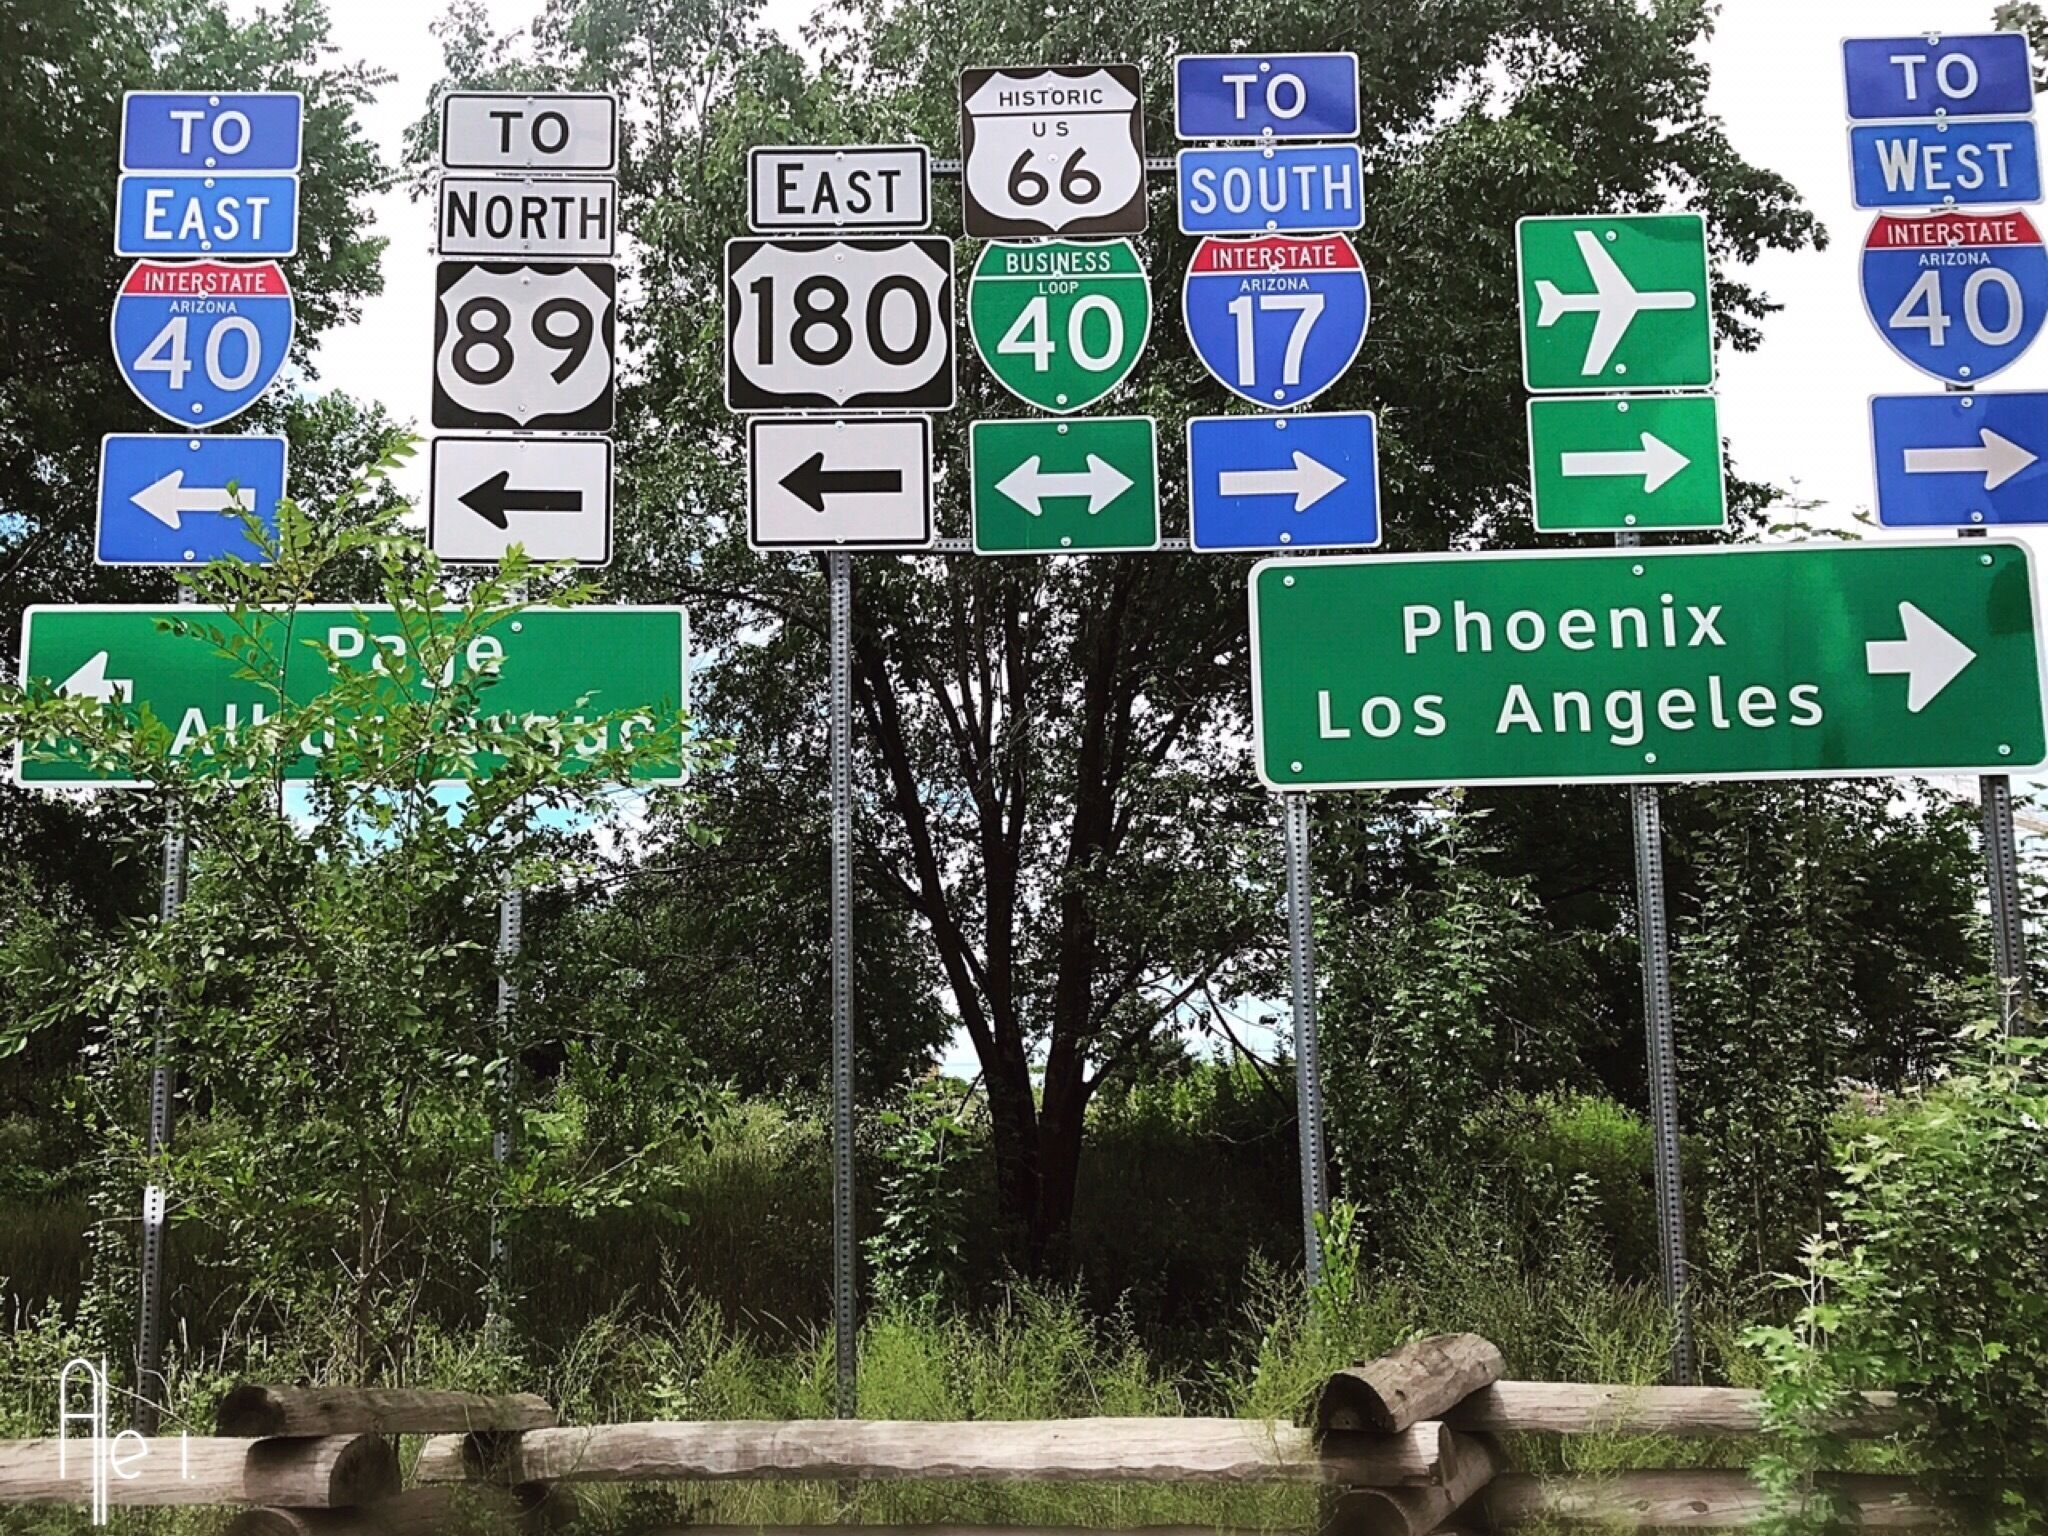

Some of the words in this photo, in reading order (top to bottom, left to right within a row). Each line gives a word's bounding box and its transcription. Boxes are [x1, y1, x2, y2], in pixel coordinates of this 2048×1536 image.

[998, 89, 1104, 106] HISTORIC
[1222, 74, 1305, 119] TO
[1890, 54, 1979, 99] TO
[169, 110, 251, 154] TO
[489, 110, 571, 154] TO
[1032, 121, 1069, 138] US
[1007, 147, 1102, 207] 66
[1875, 136, 2013, 192] WEST
[776, 163, 901, 215] EAST
[1189, 164, 1353, 215] SOUTH
[143, 189, 270, 241] EAST
[446, 190, 607, 241] NORTH
[1887, 221, 2018, 244] INTERSTATE
[1006, 252, 1111, 273] BUSINESS
[1211, 243, 1337, 269] INTERSTATE
[1918, 251, 1991, 266] ARIZONA
[144, 272, 267, 293] INTERSTATE
[1039, 281, 1079, 294] LOOP
[1240, 277, 1310, 292] ARIZONA
[169, 301, 238, 314] ARIZONA
[750, 275, 931, 366] 180
[1889, 268, 2024, 347] 40
[133, 316, 262, 391] 40
[451, 297, 593, 385] 89
[997, 295, 1124, 372] 40
[1228, 294, 1325, 387] 17
[1402, 593, 1727, 654] Phoenix
[1318, 689, 1447, 739] Los
[1496, 676, 1823, 746] Angeles
